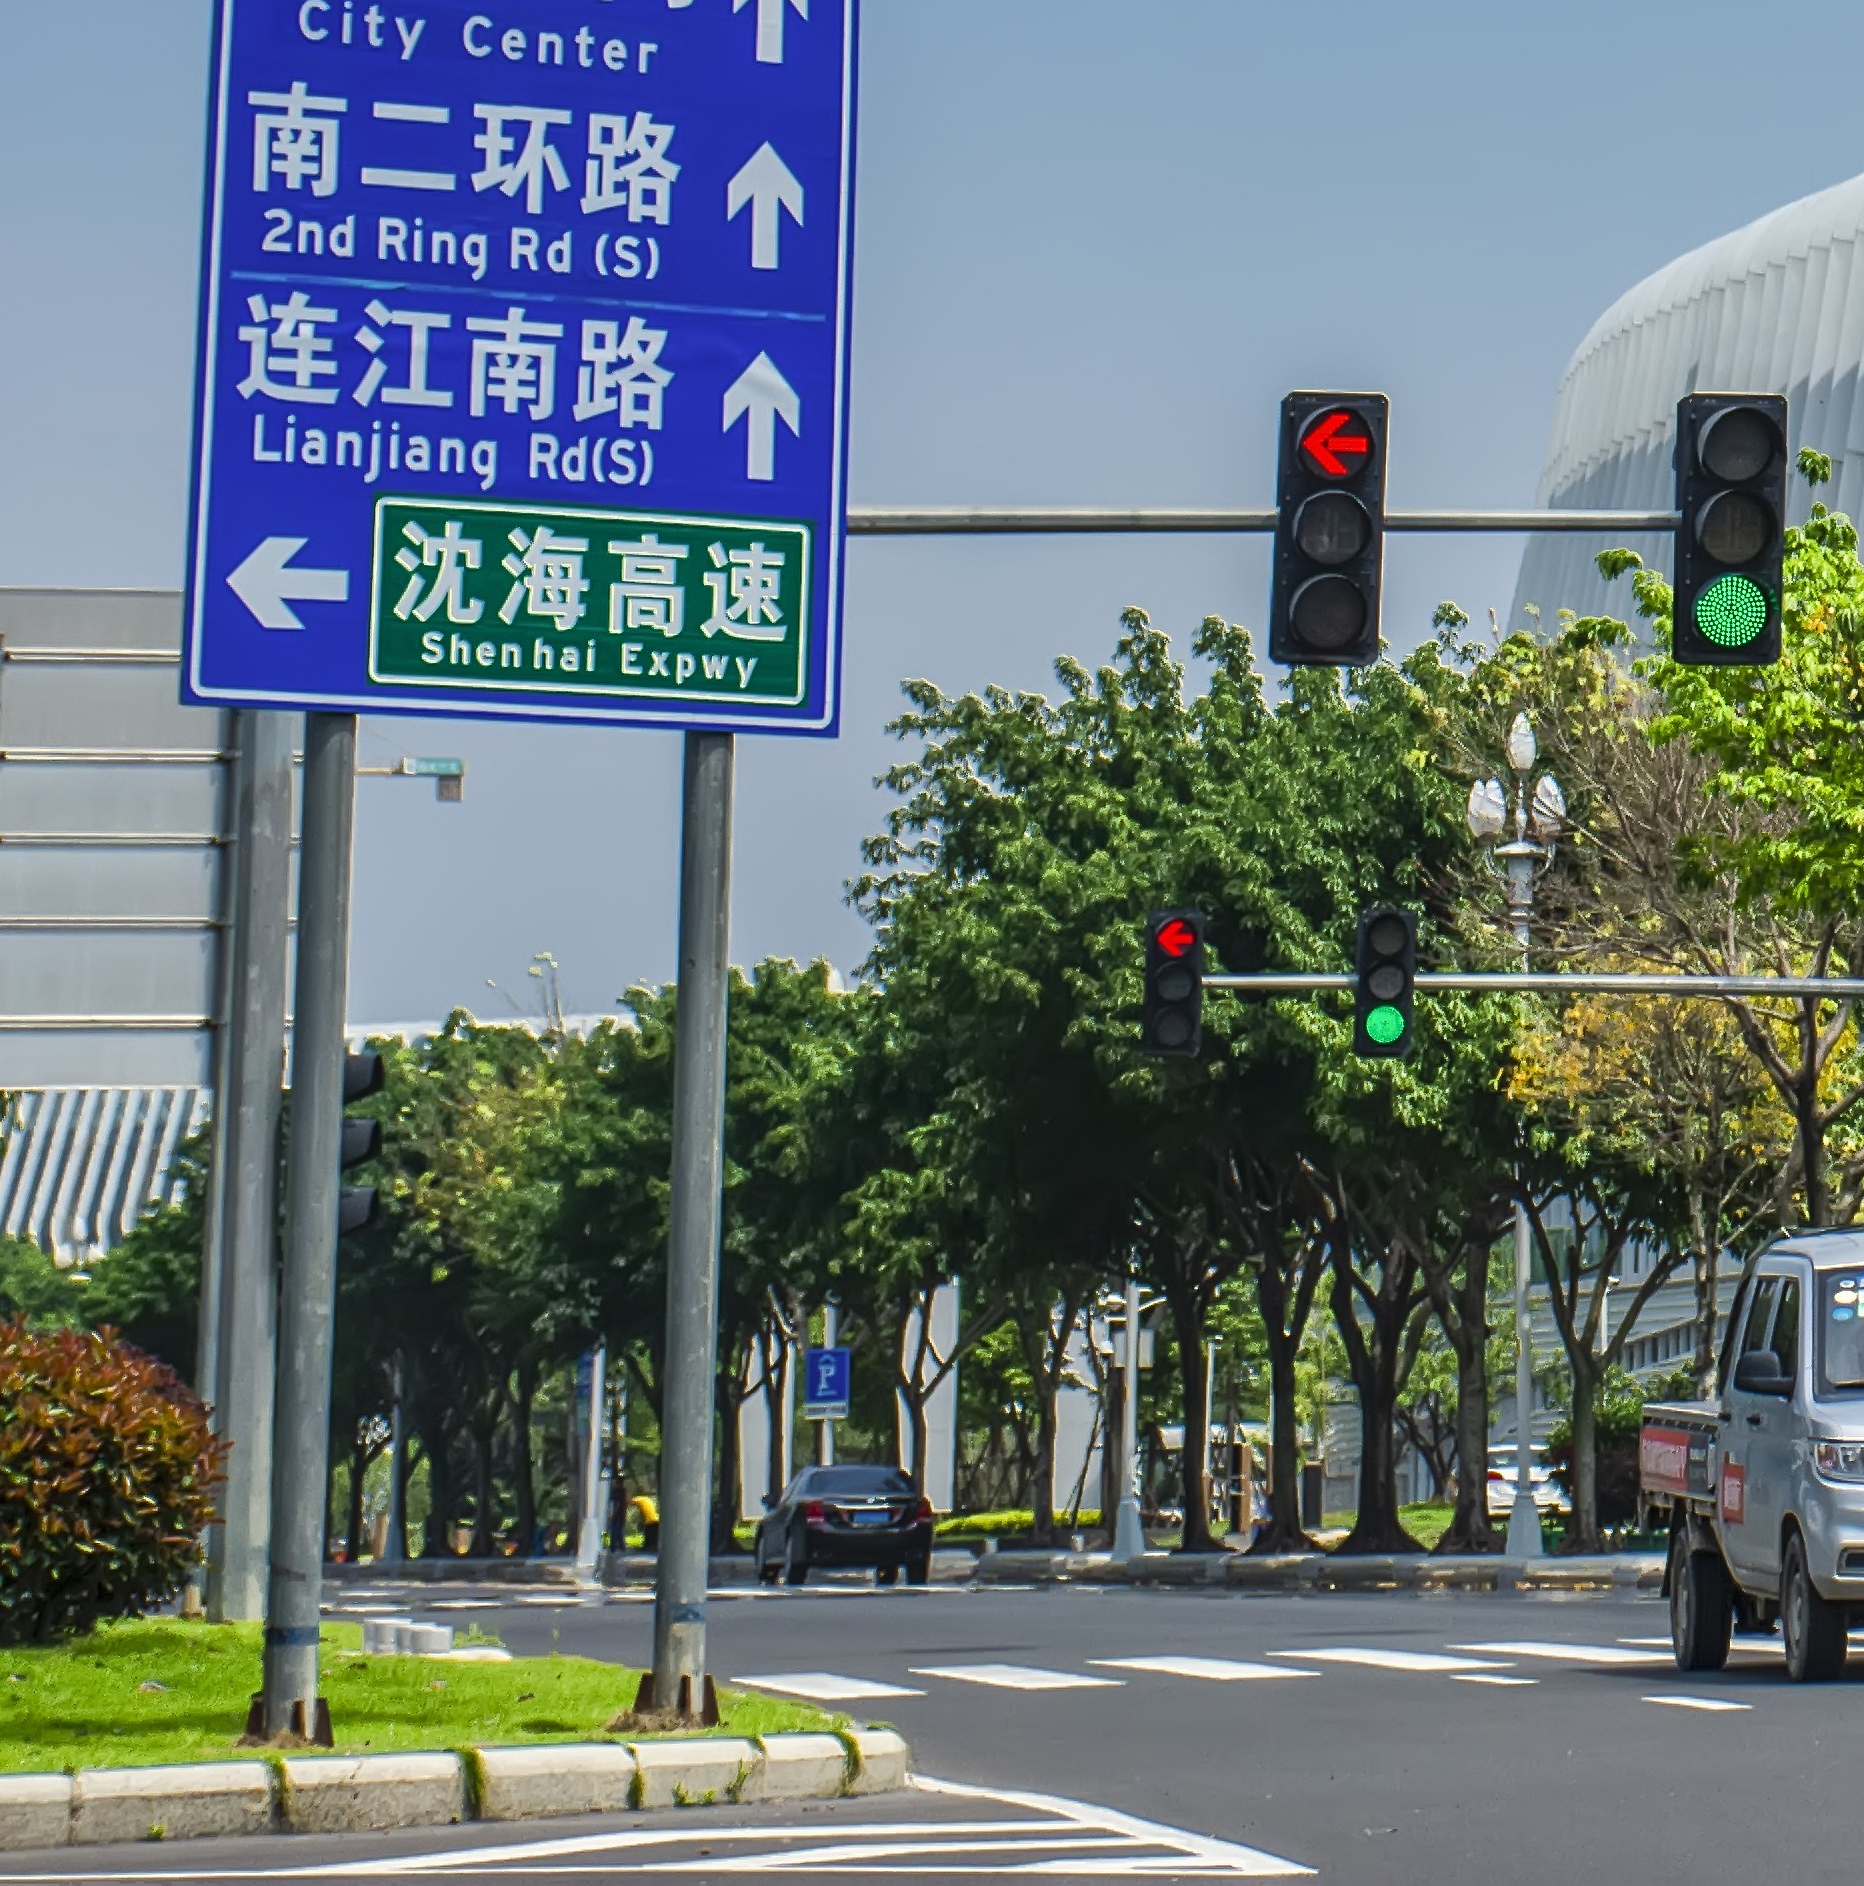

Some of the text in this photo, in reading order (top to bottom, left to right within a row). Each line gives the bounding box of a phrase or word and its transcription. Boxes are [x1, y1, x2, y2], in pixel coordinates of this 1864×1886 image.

[463, 15, 658, 74] Center
[248, 81, 682, 225] 南二环路
[262, 208, 661, 281] 2nd Ring Rd (S)
[235, 291, 675, 430] 连江南路
[253, 415, 655, 490] Lianjiang Rd(S)
[394, 520, 788, 641] 沈海高速
[421, 632, 759, 688] Shenhai Expwy
